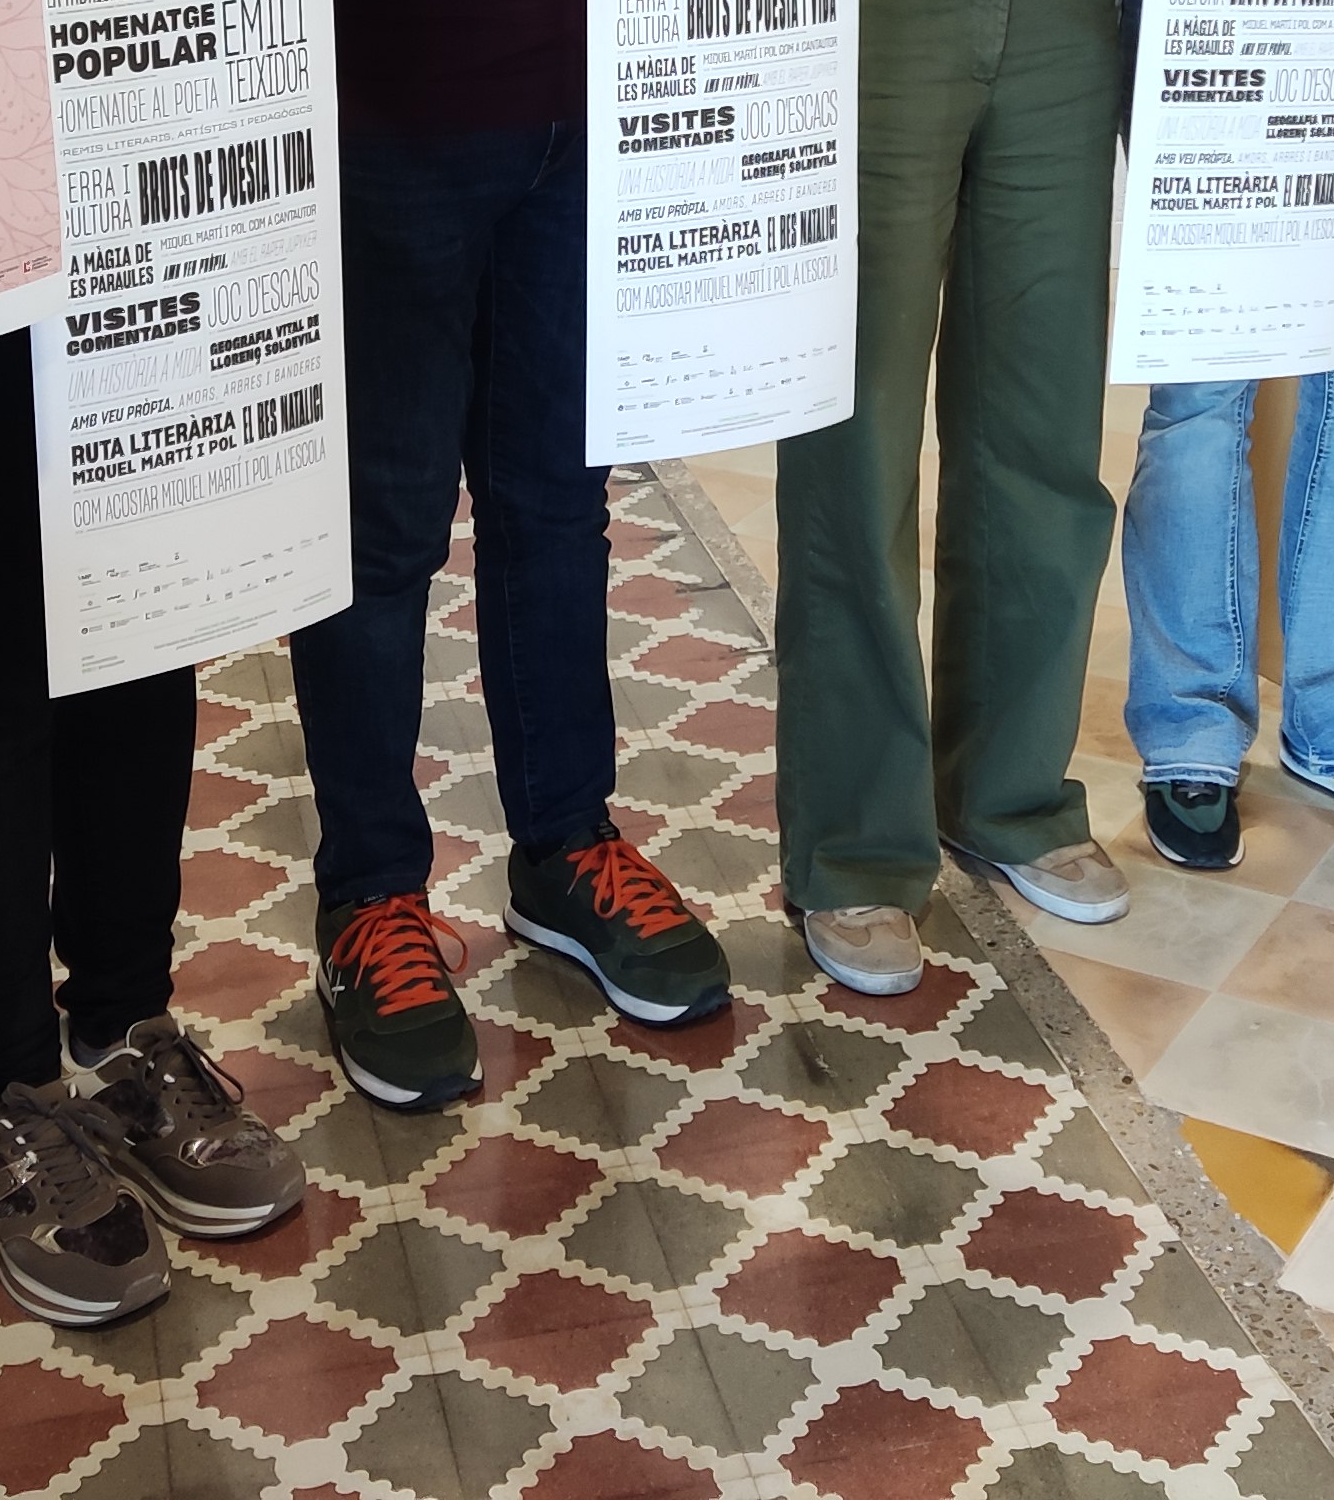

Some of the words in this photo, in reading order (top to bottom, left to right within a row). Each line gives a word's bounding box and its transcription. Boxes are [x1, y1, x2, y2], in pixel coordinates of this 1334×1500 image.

[49, 2, 215, 49] HOMENATGE
[617, 14, 679, 47] CULTURA
[52, 31, 217, 84] POPULAR
[225, 47, 309, 106] TEIXIDOR
[618, 60, 633, 81] LA
[637, 55, 677, 80] MÀGIA
[682, 55, 696, 74] DE
[1163, 68, 1266, 88] VISITES
[153, 85, 170, 119] AL
[174, 77, 219, 116] POETA
[618, 83, 637, 102] LES
[642, 78, 697, 100] PARAULES
[1161, 89, 1264, 103] COMENTADES
[60, 144, 104, 157] REMIS
[177, 121, 237, 139] ARTÍSTICS
[247, 105, 313, 125] PEDAGÒGICS
[618, 105, 735, 137] VISITES
[741, 100, 771, 141] JOC
[777, 89, 839, 135] D'ESCACS
[619, 128, 735, 154] COMENTADES
[138, 153, 190, 227] BROTS
[194, 150, 214, 215] DE
[217, 138, 270, 210] POESIA
[274, 135, 279, 198] I
[282, 128, 315, 194] VIDA
[1152, 176, 1191, 195] RUTA
[1197, 170, 1279, 194] LITERÀRIA
[618, 232, 663, 255] RUTA
[670, 214, 761, 250] LITERÀRIA
[66, 292, 201, 338] VISITES
[208, 281, 241, 328] JOC
[249, 261, 319, 318] D'ESCACS
[66, 316, 201, 356] COMENTADES
[210, 329, 273, 356] GEOGRAFIA
[276, 319, 304, 338] VITAL
[307, 314, 319, 329] DE
[210, 349, 260, 371] LLORENÇ
[71, 438, 124, 467] RUTA
[130, 411, 236, 455] LITERÀRIA
[72, 463, 136, 486] MIQUEL
[141, 438, 193, 471] MARTÍ
[197, 443, 204, 457] I
[209, 435, 237, 455] POL
